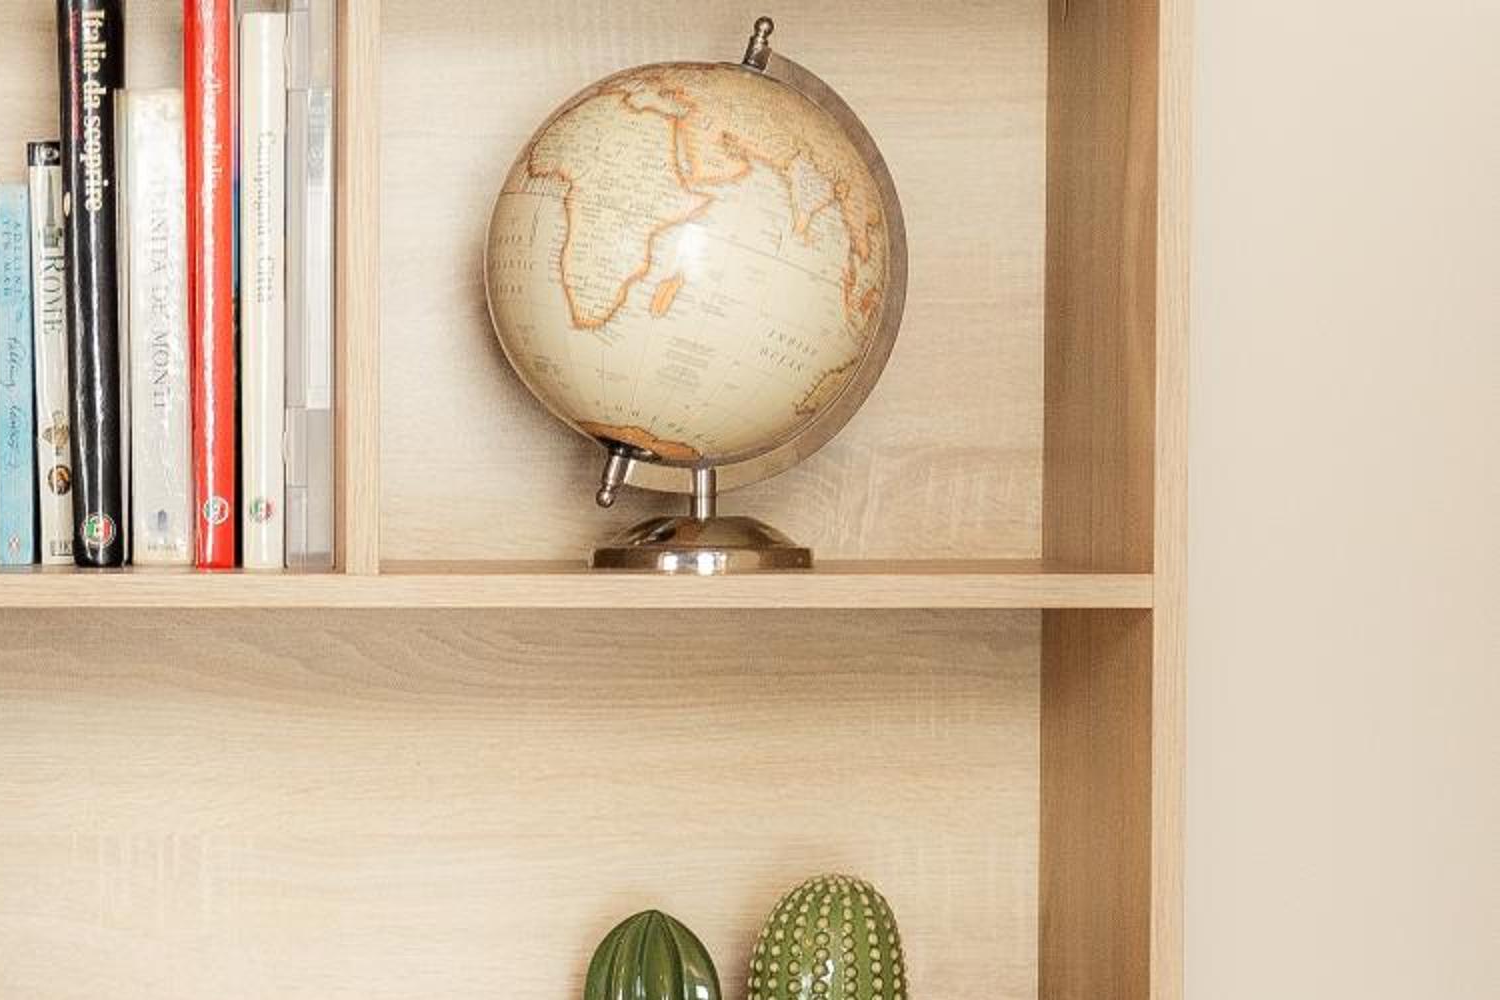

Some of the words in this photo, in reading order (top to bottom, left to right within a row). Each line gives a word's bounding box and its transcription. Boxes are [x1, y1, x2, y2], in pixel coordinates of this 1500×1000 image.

[82, 9, 106, 75] Italia
[83, 79, 107, 109] da
[79, 115, 109, 211] scoprire
[43, 255, 69, 336] ROME
[151, 329, 170, 410] MONTI
